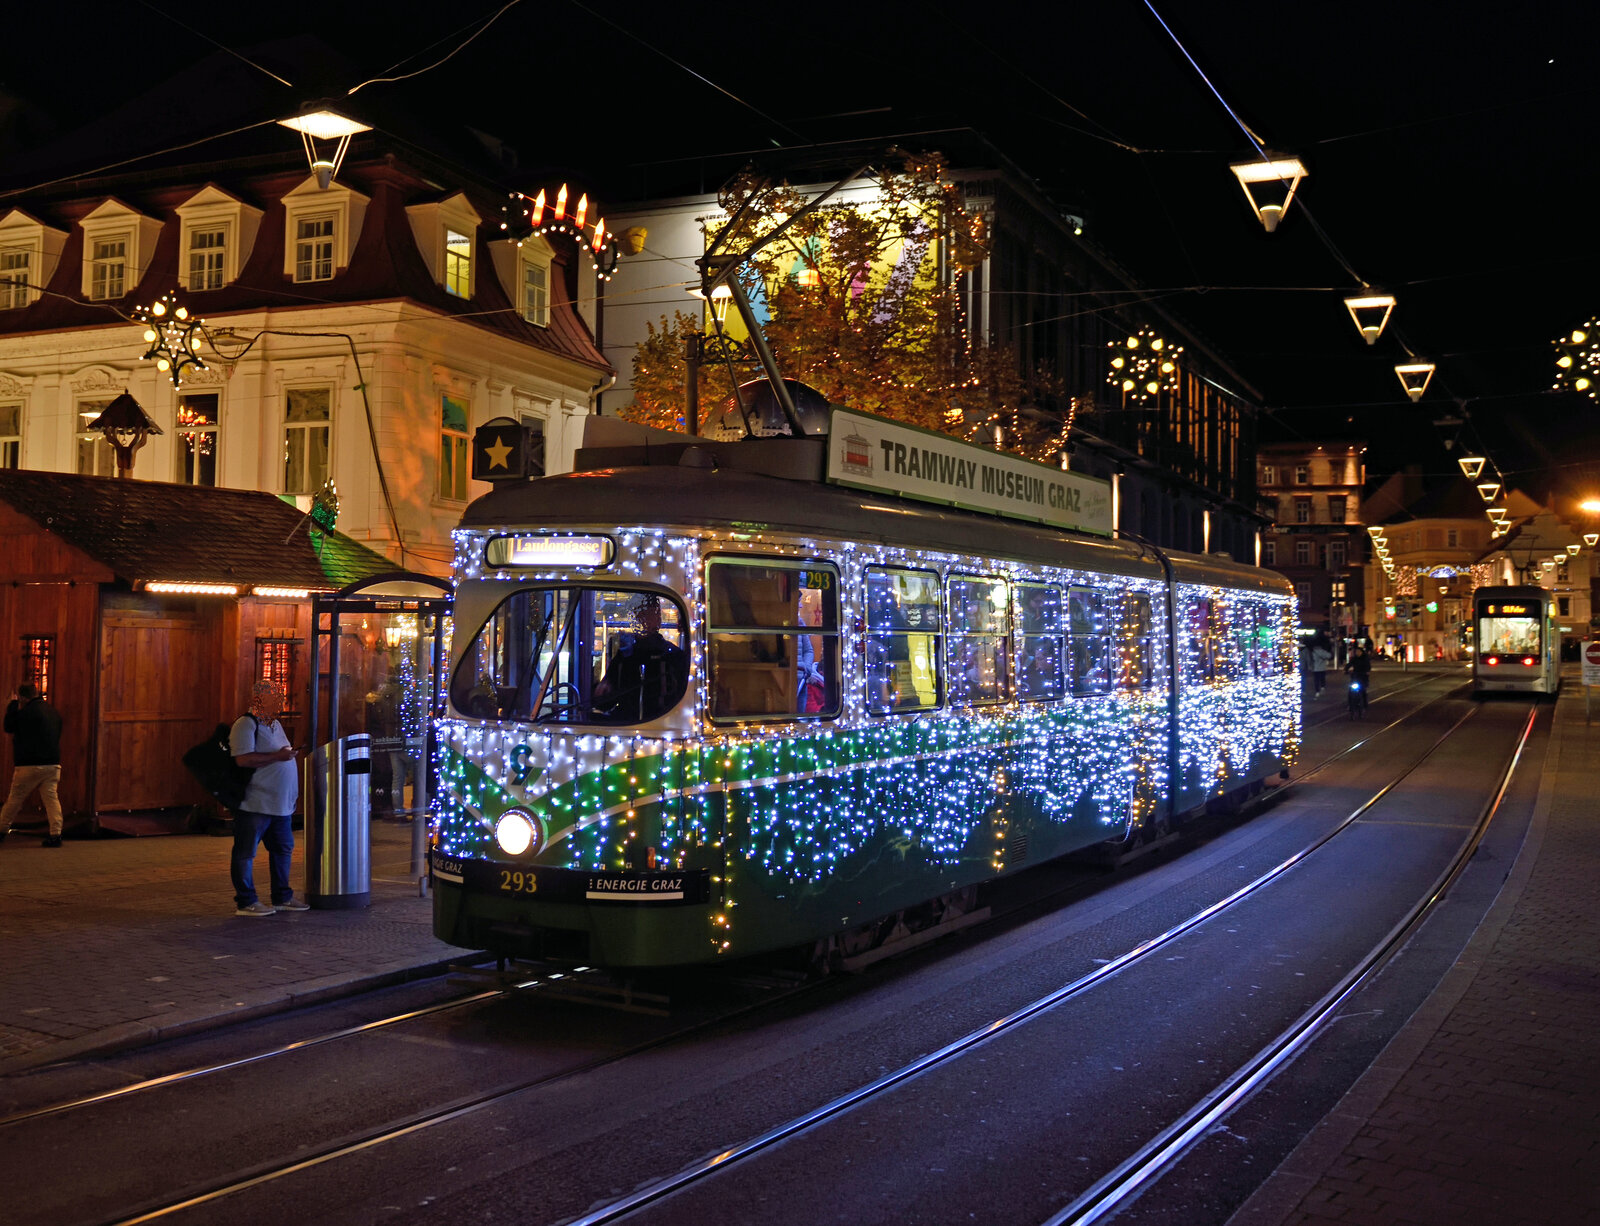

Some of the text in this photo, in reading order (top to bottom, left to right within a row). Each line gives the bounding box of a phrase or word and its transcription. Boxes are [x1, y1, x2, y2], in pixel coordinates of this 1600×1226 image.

[880, 439, 977, 490] TRAMWAY
[981, 464, 1045, 506] MUSEUM
[1047, 482, 1081, 513] GRAZ
[516, 537, 600, 556] Laudongasse
[807, 571, 831, 590] 293
[444, 860, 464, 874] GRAZ
[500, 870, 538, 893] 293
[596, 878, 683, 891] ENERGIE GRAZ
